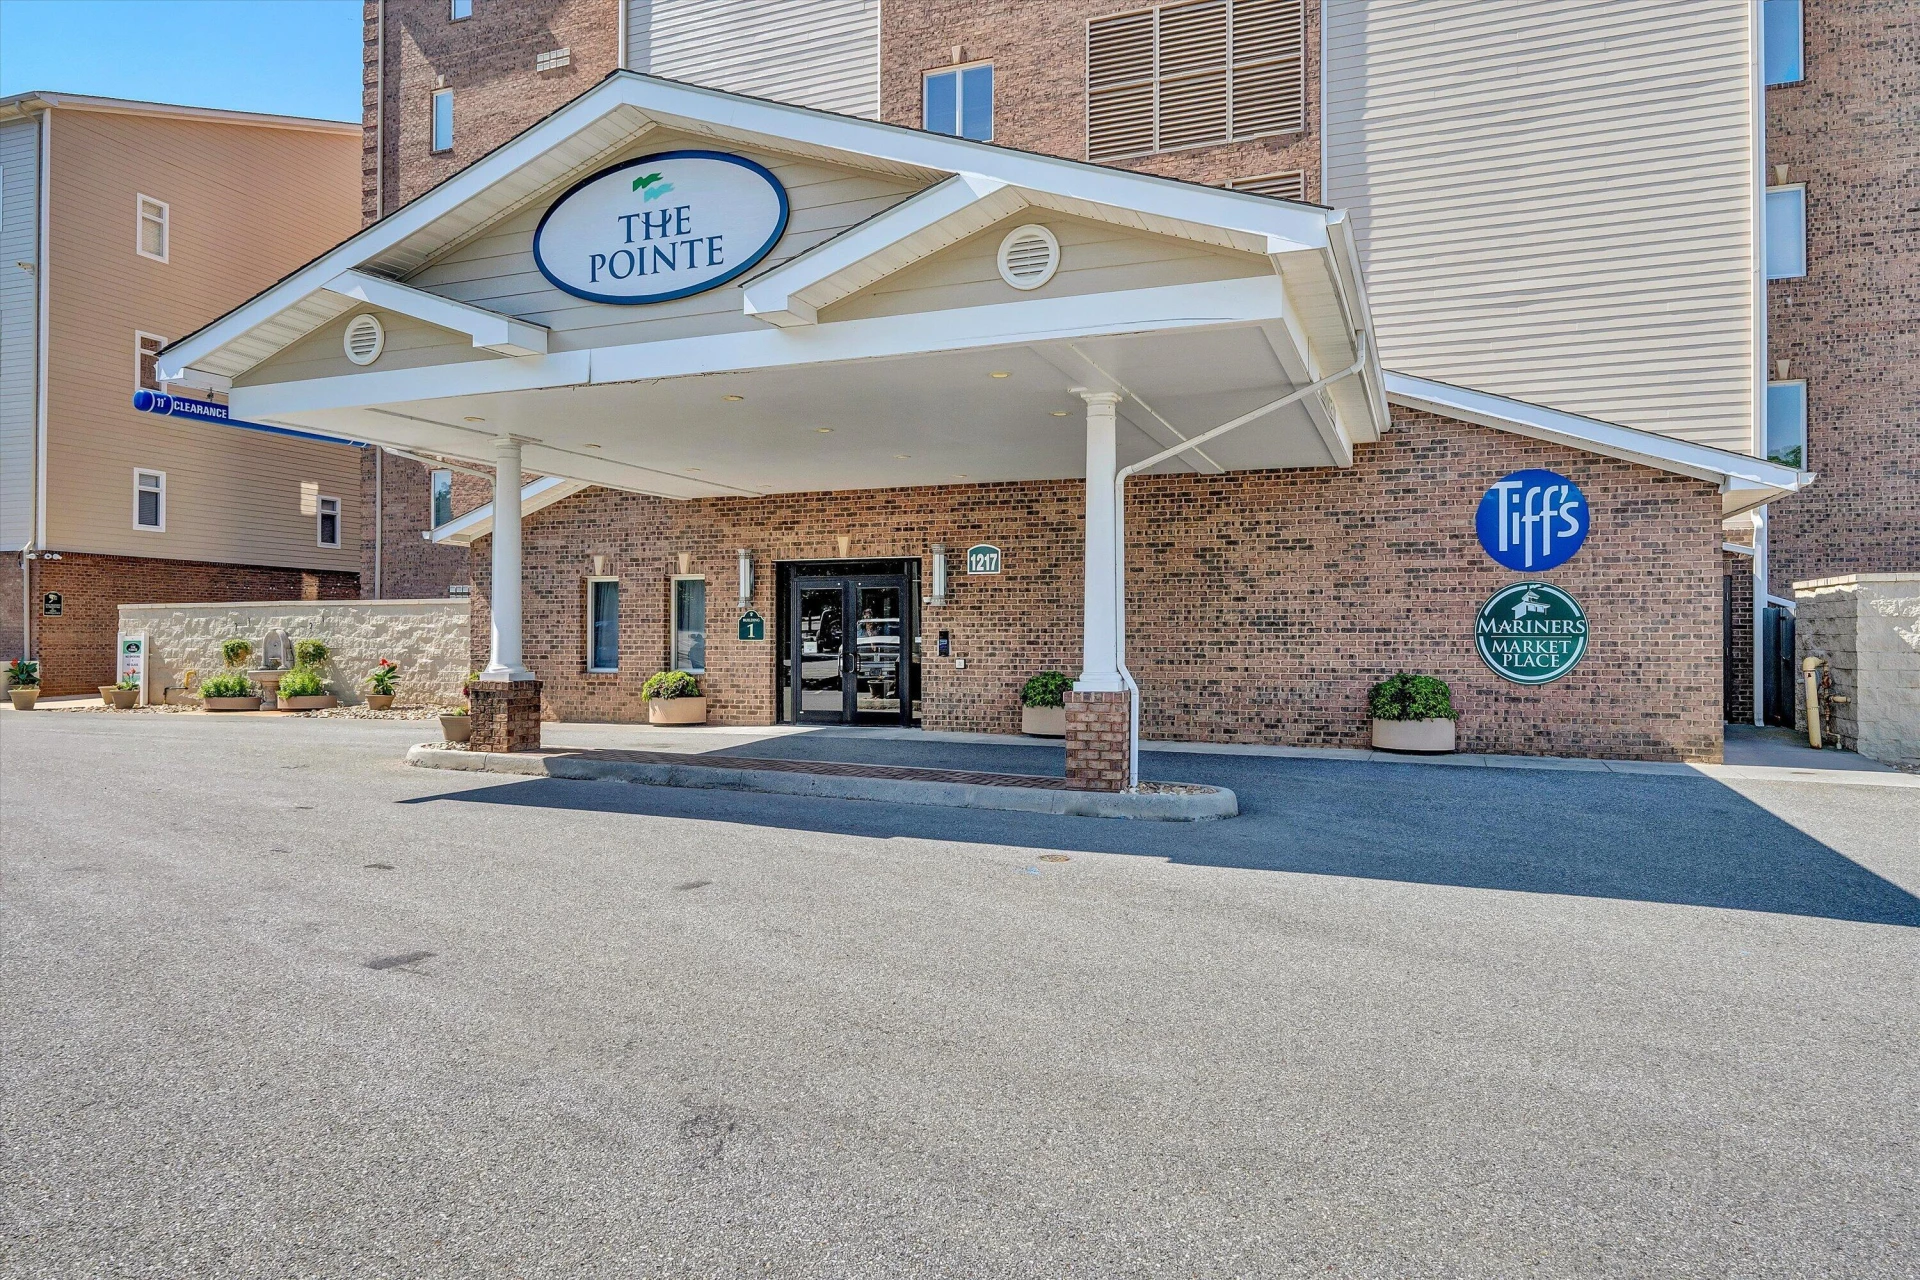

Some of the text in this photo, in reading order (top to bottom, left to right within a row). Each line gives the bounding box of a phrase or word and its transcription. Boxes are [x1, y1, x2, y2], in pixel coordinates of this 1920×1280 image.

[618, 205, 692, 244] THE
[588, 235, 725, 283] POINTE
[174, 401, 227, 419] CLEARANCE
[1490, 480, 1580, 568] Tiff's
[970, 553, 998, 571] 1217
[746, 623, 755, 638] 1
[1477, 617, 1585, 635] MARINERS
[1491, 640, 1572, 654] MARKET
[1502, 654, 1560, 668] PLACE
